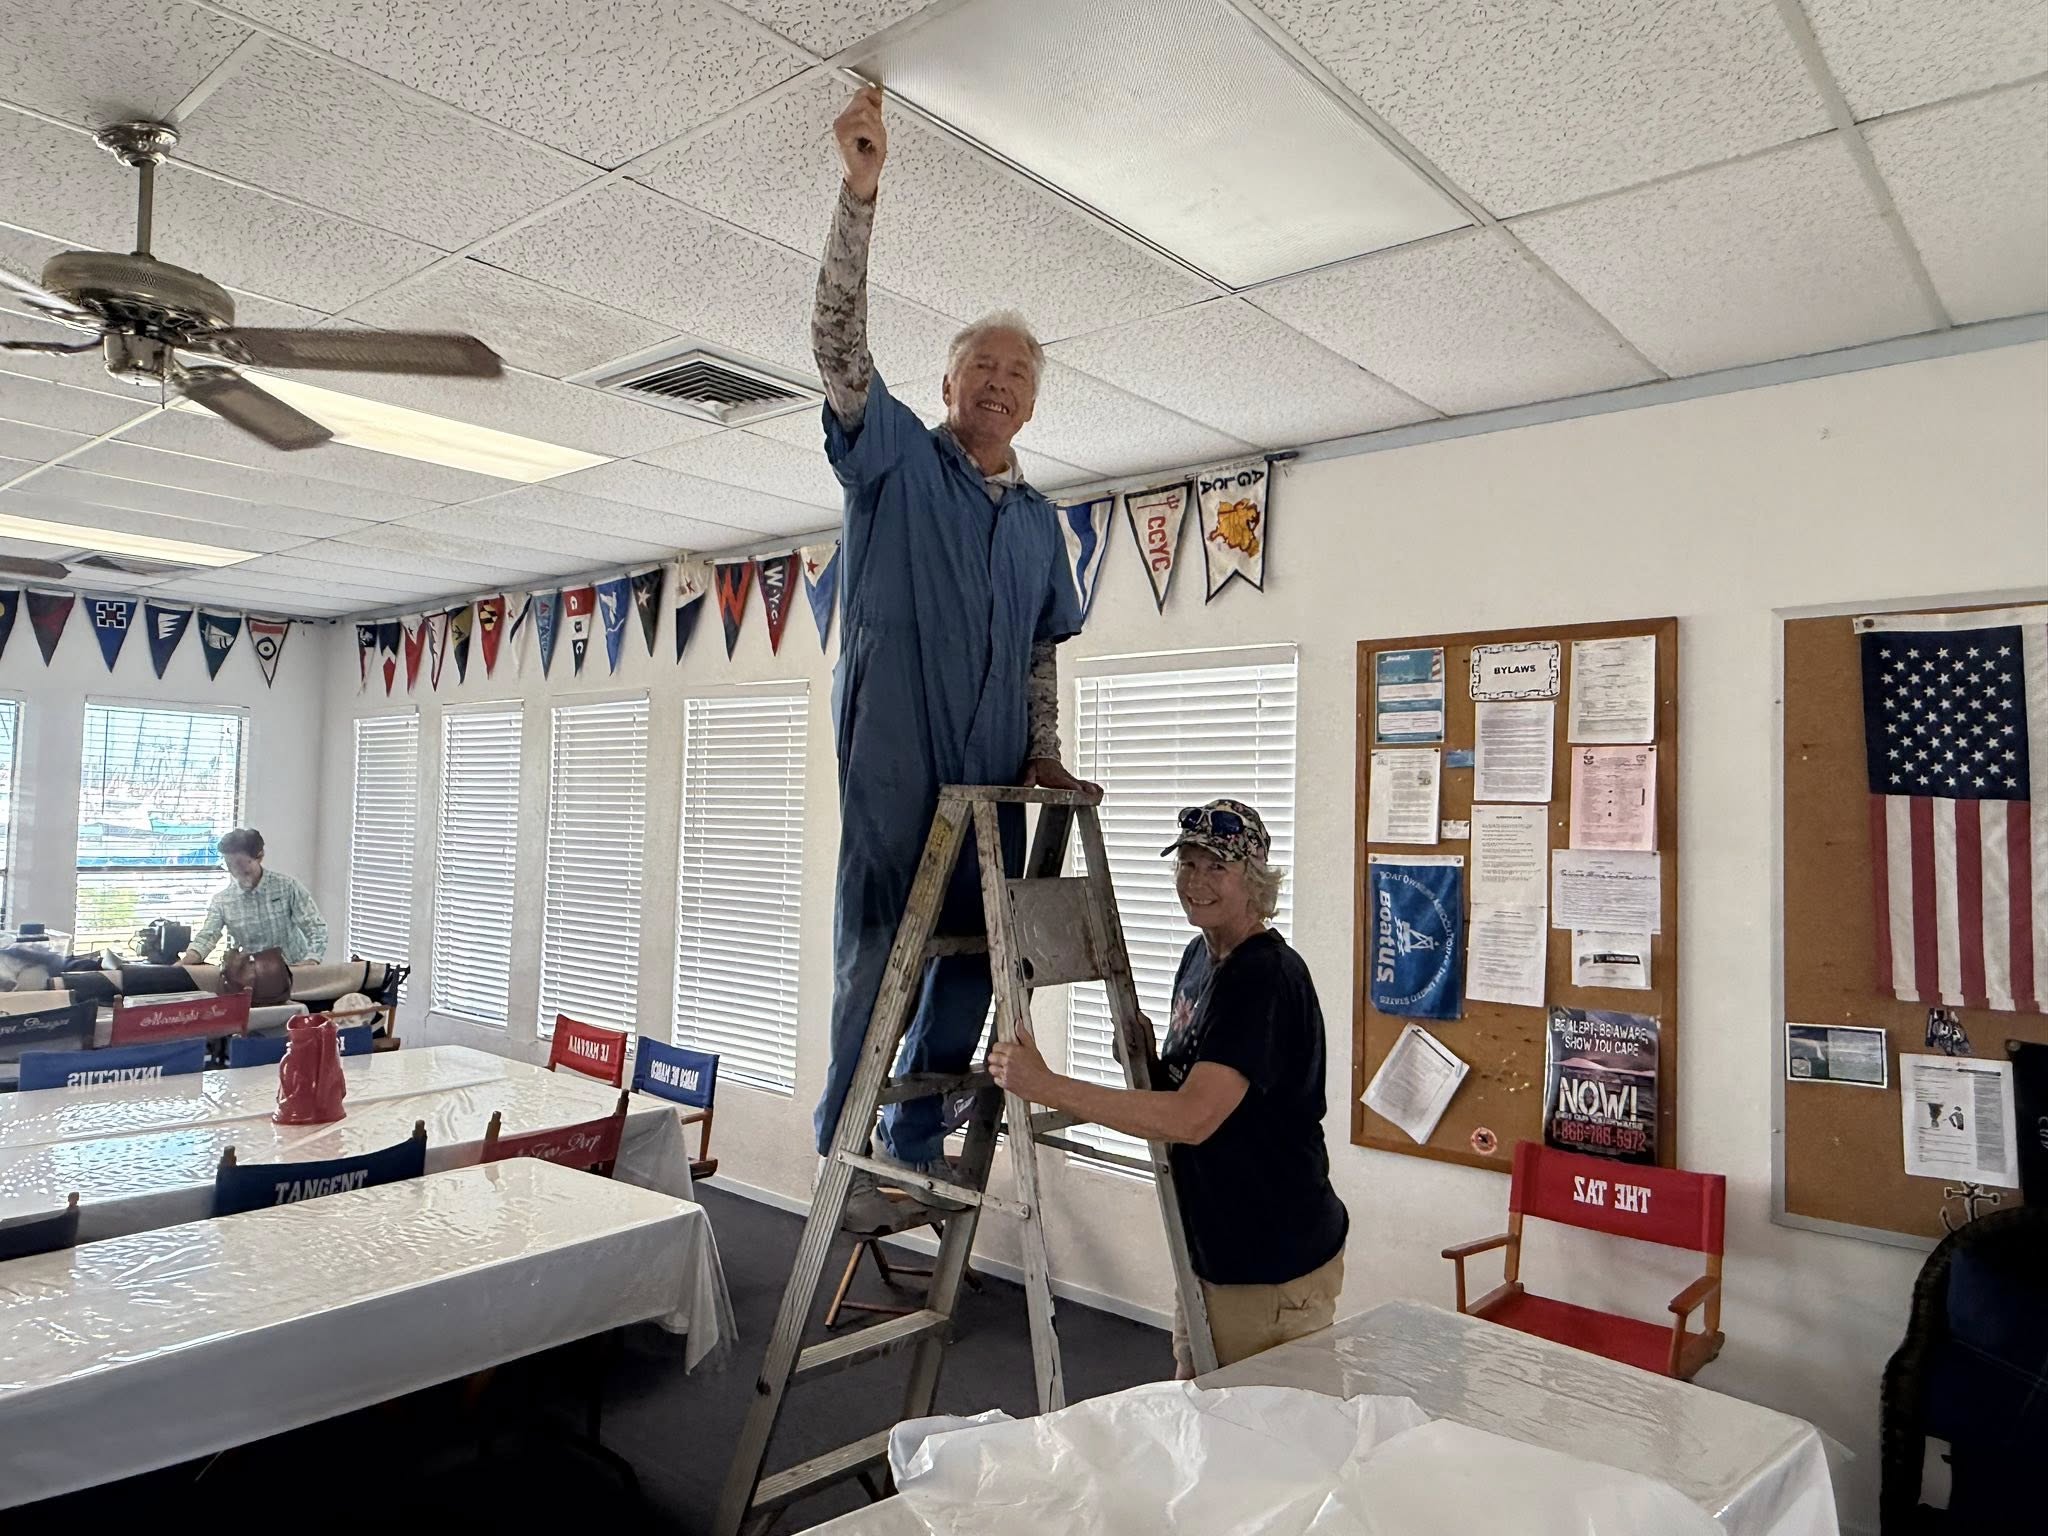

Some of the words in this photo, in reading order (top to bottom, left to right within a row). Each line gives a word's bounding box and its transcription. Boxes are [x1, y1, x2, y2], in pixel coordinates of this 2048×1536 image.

[1147, 516, 1171, 572] CCYC
[1494, 665, 1536, 674] BYLAWS
[1554, 1018, 1566, 1032] BE
[1565, 1036, 1592, 1051] SHOW
[1595, 1039, 1612, 1053] YOU
[1560, 1076, 1638, 1122] NOW!
[275, 1169, 368, 1204] TANGENT
